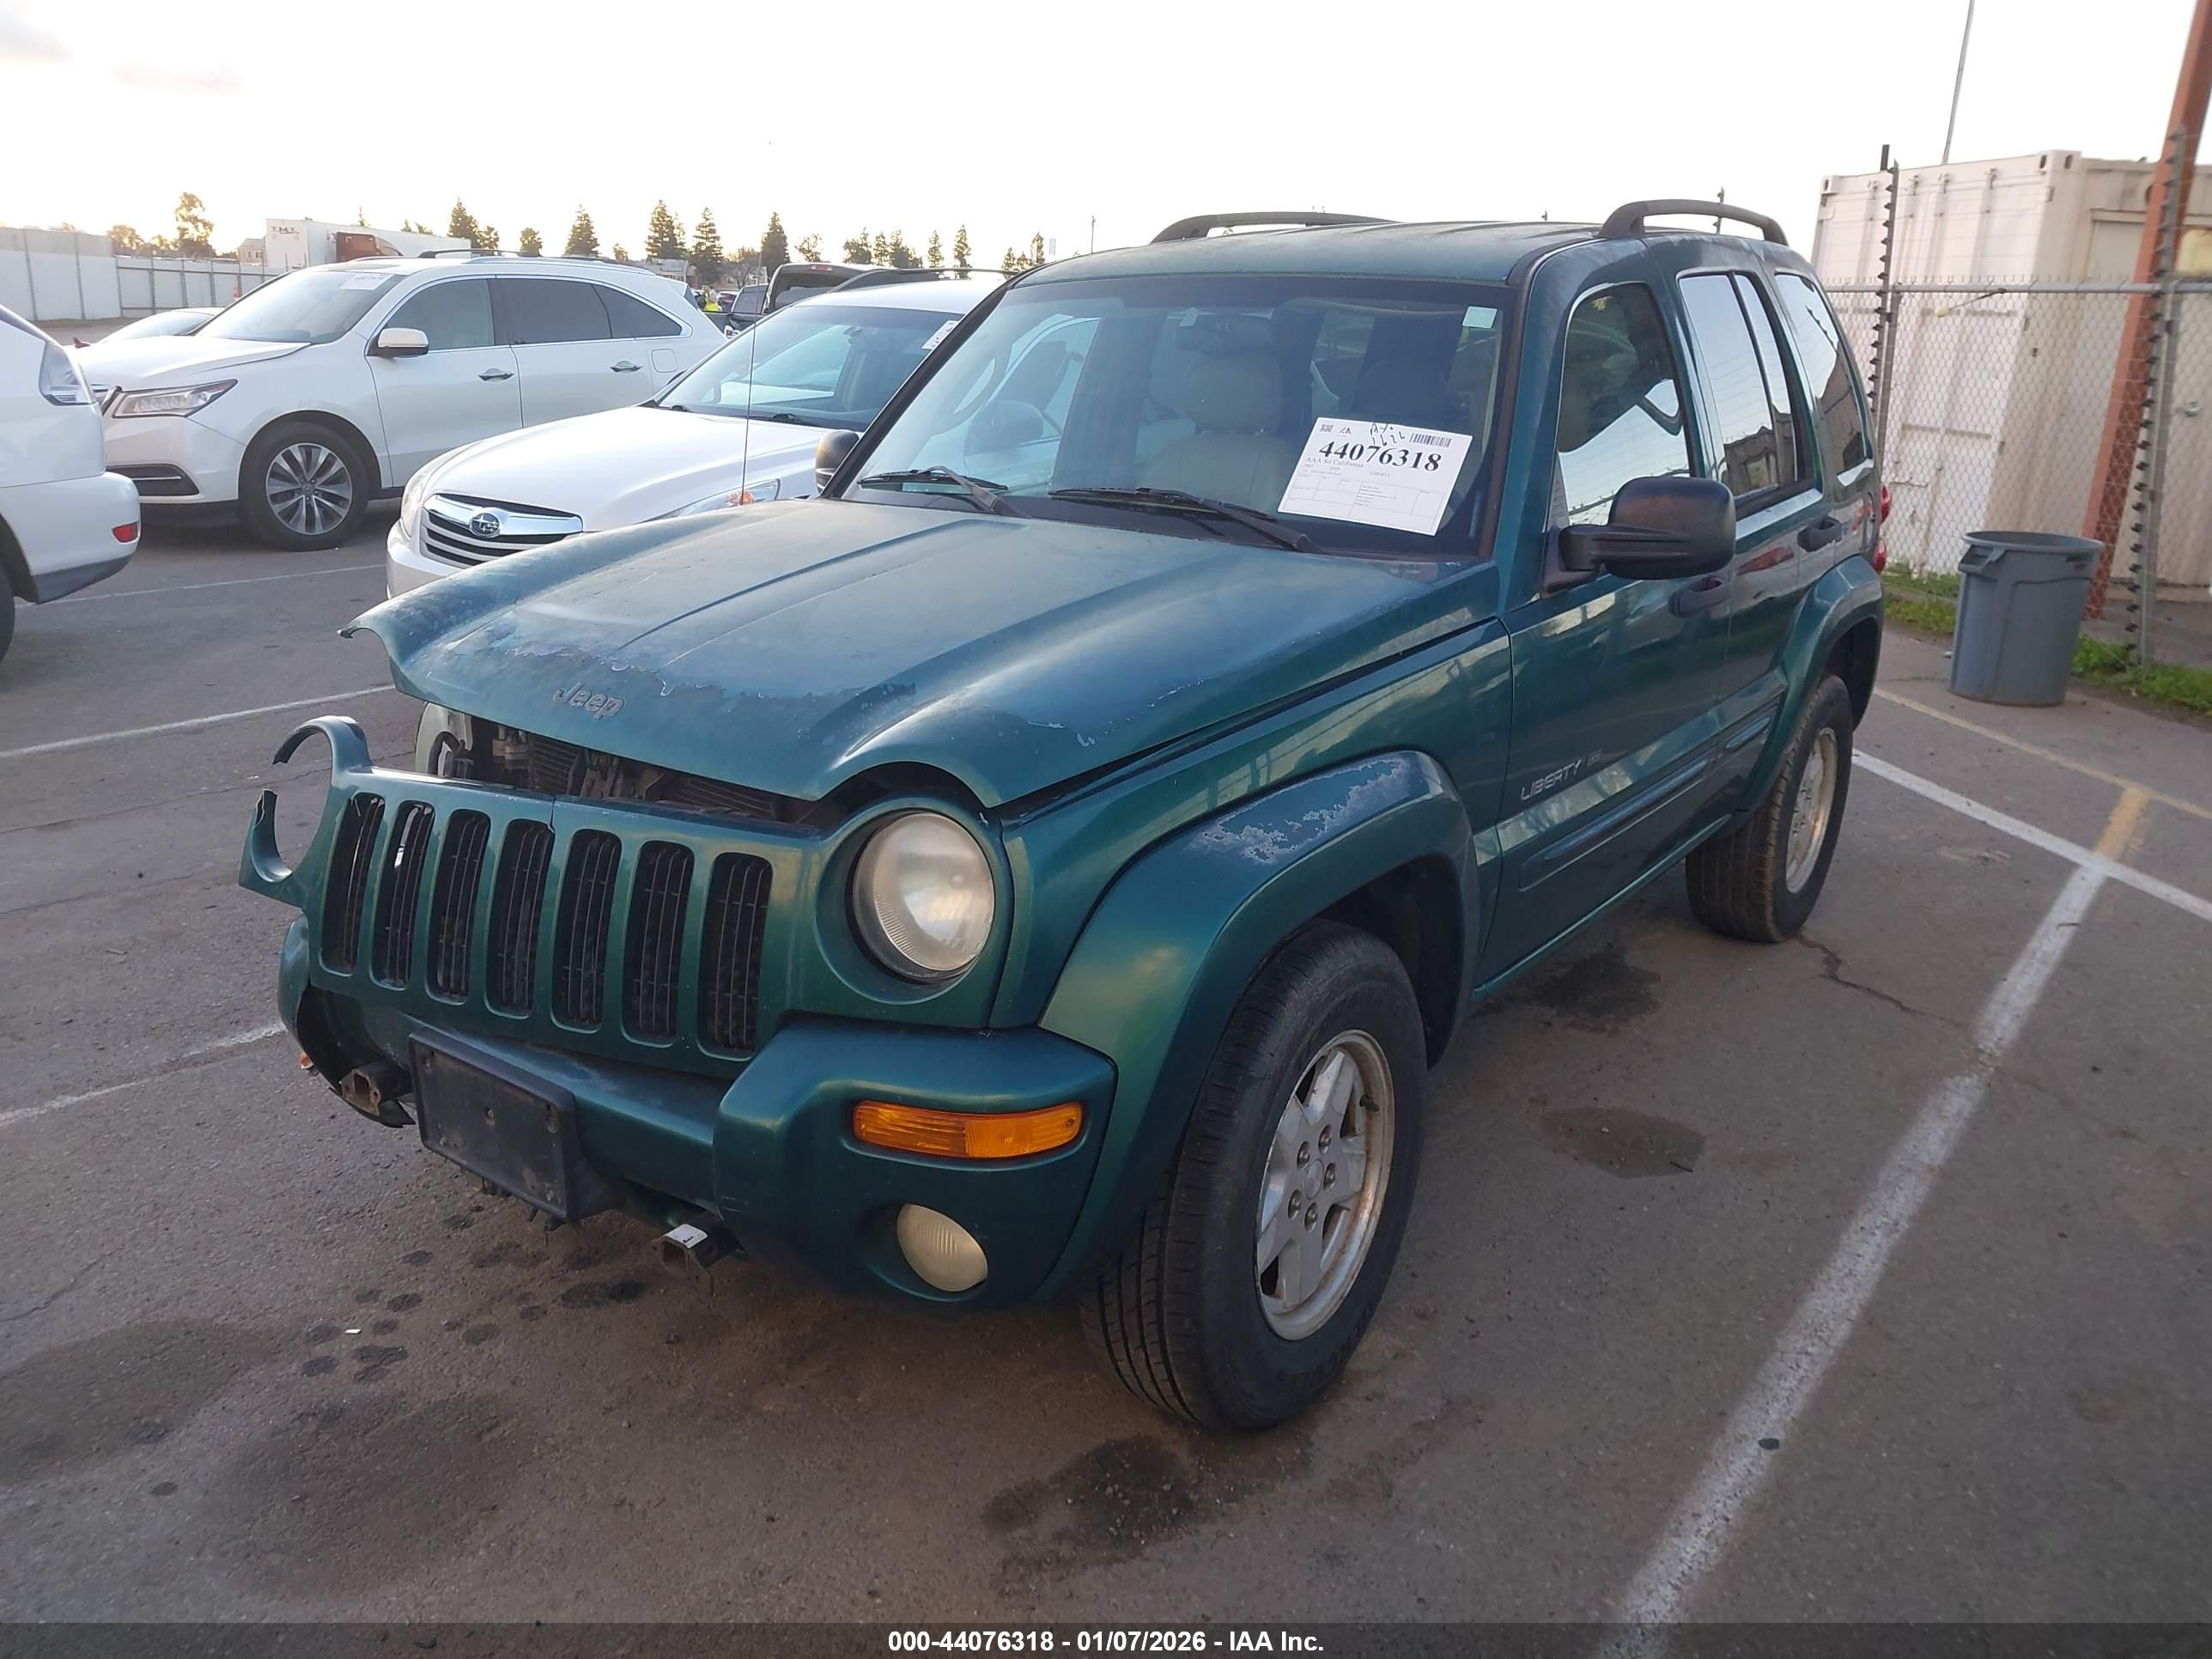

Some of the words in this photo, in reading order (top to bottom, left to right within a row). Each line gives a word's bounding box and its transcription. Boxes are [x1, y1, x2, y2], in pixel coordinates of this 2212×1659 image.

[1318, 441, 1442, 471] 44076318
[553, 682, 625, 720] Jeep
[1520, 759, 1582, 800] LIBERTY
